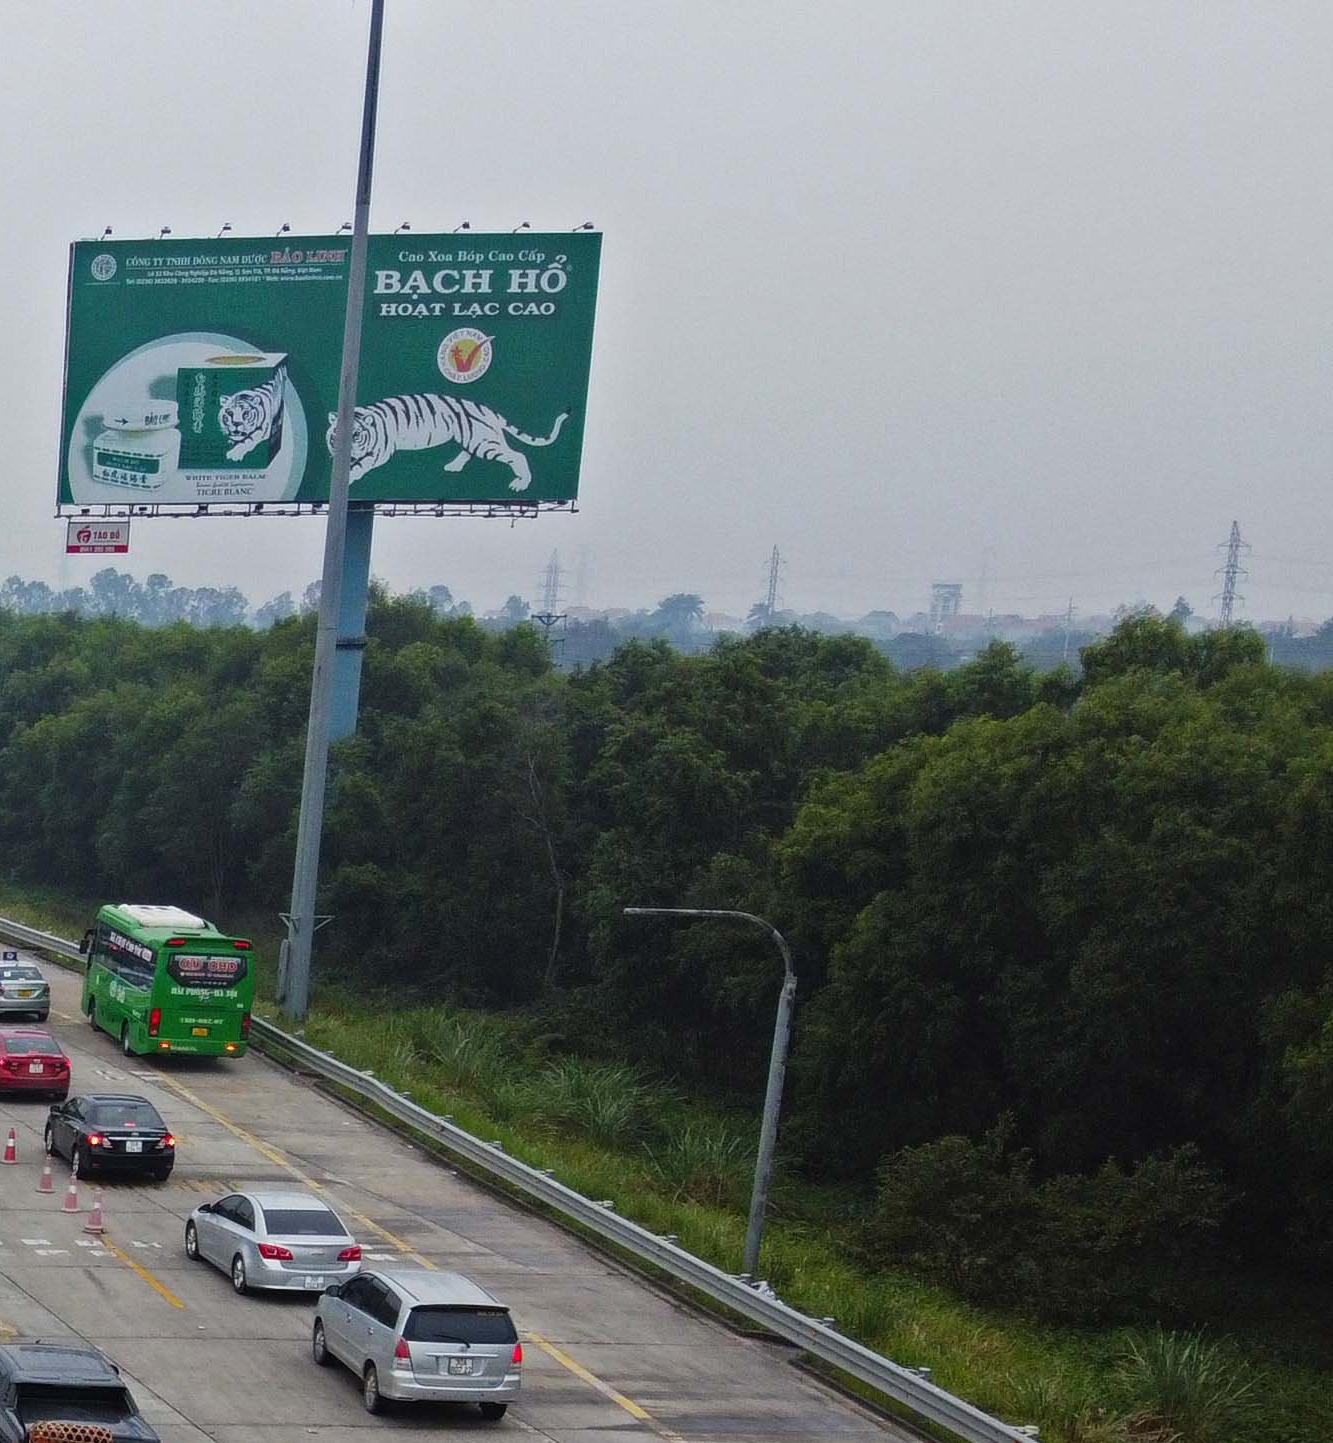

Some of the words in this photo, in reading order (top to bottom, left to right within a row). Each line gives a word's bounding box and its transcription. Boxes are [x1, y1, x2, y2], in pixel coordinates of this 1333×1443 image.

[126, 255, 151, 266] CÔNG
[153, 255, 165, 266] TY
[220, 255, 240, 265] NAM
[398, 251, 424, 262] Cao
[428, 251, 453, 262] Xoa
[458, 250, 483, 264] Bóp
[488, 250, 514, 262] Cao
[518, 249, 546, 263] Cấp
[373, 270, 493, 299] BẠCH
[507, 254, 567, 294] HỔ
[379, 303, 445, 319] HOẠT
[453, 302, 500, 318] LẠC
[507, 302, 555, 316] CAO
